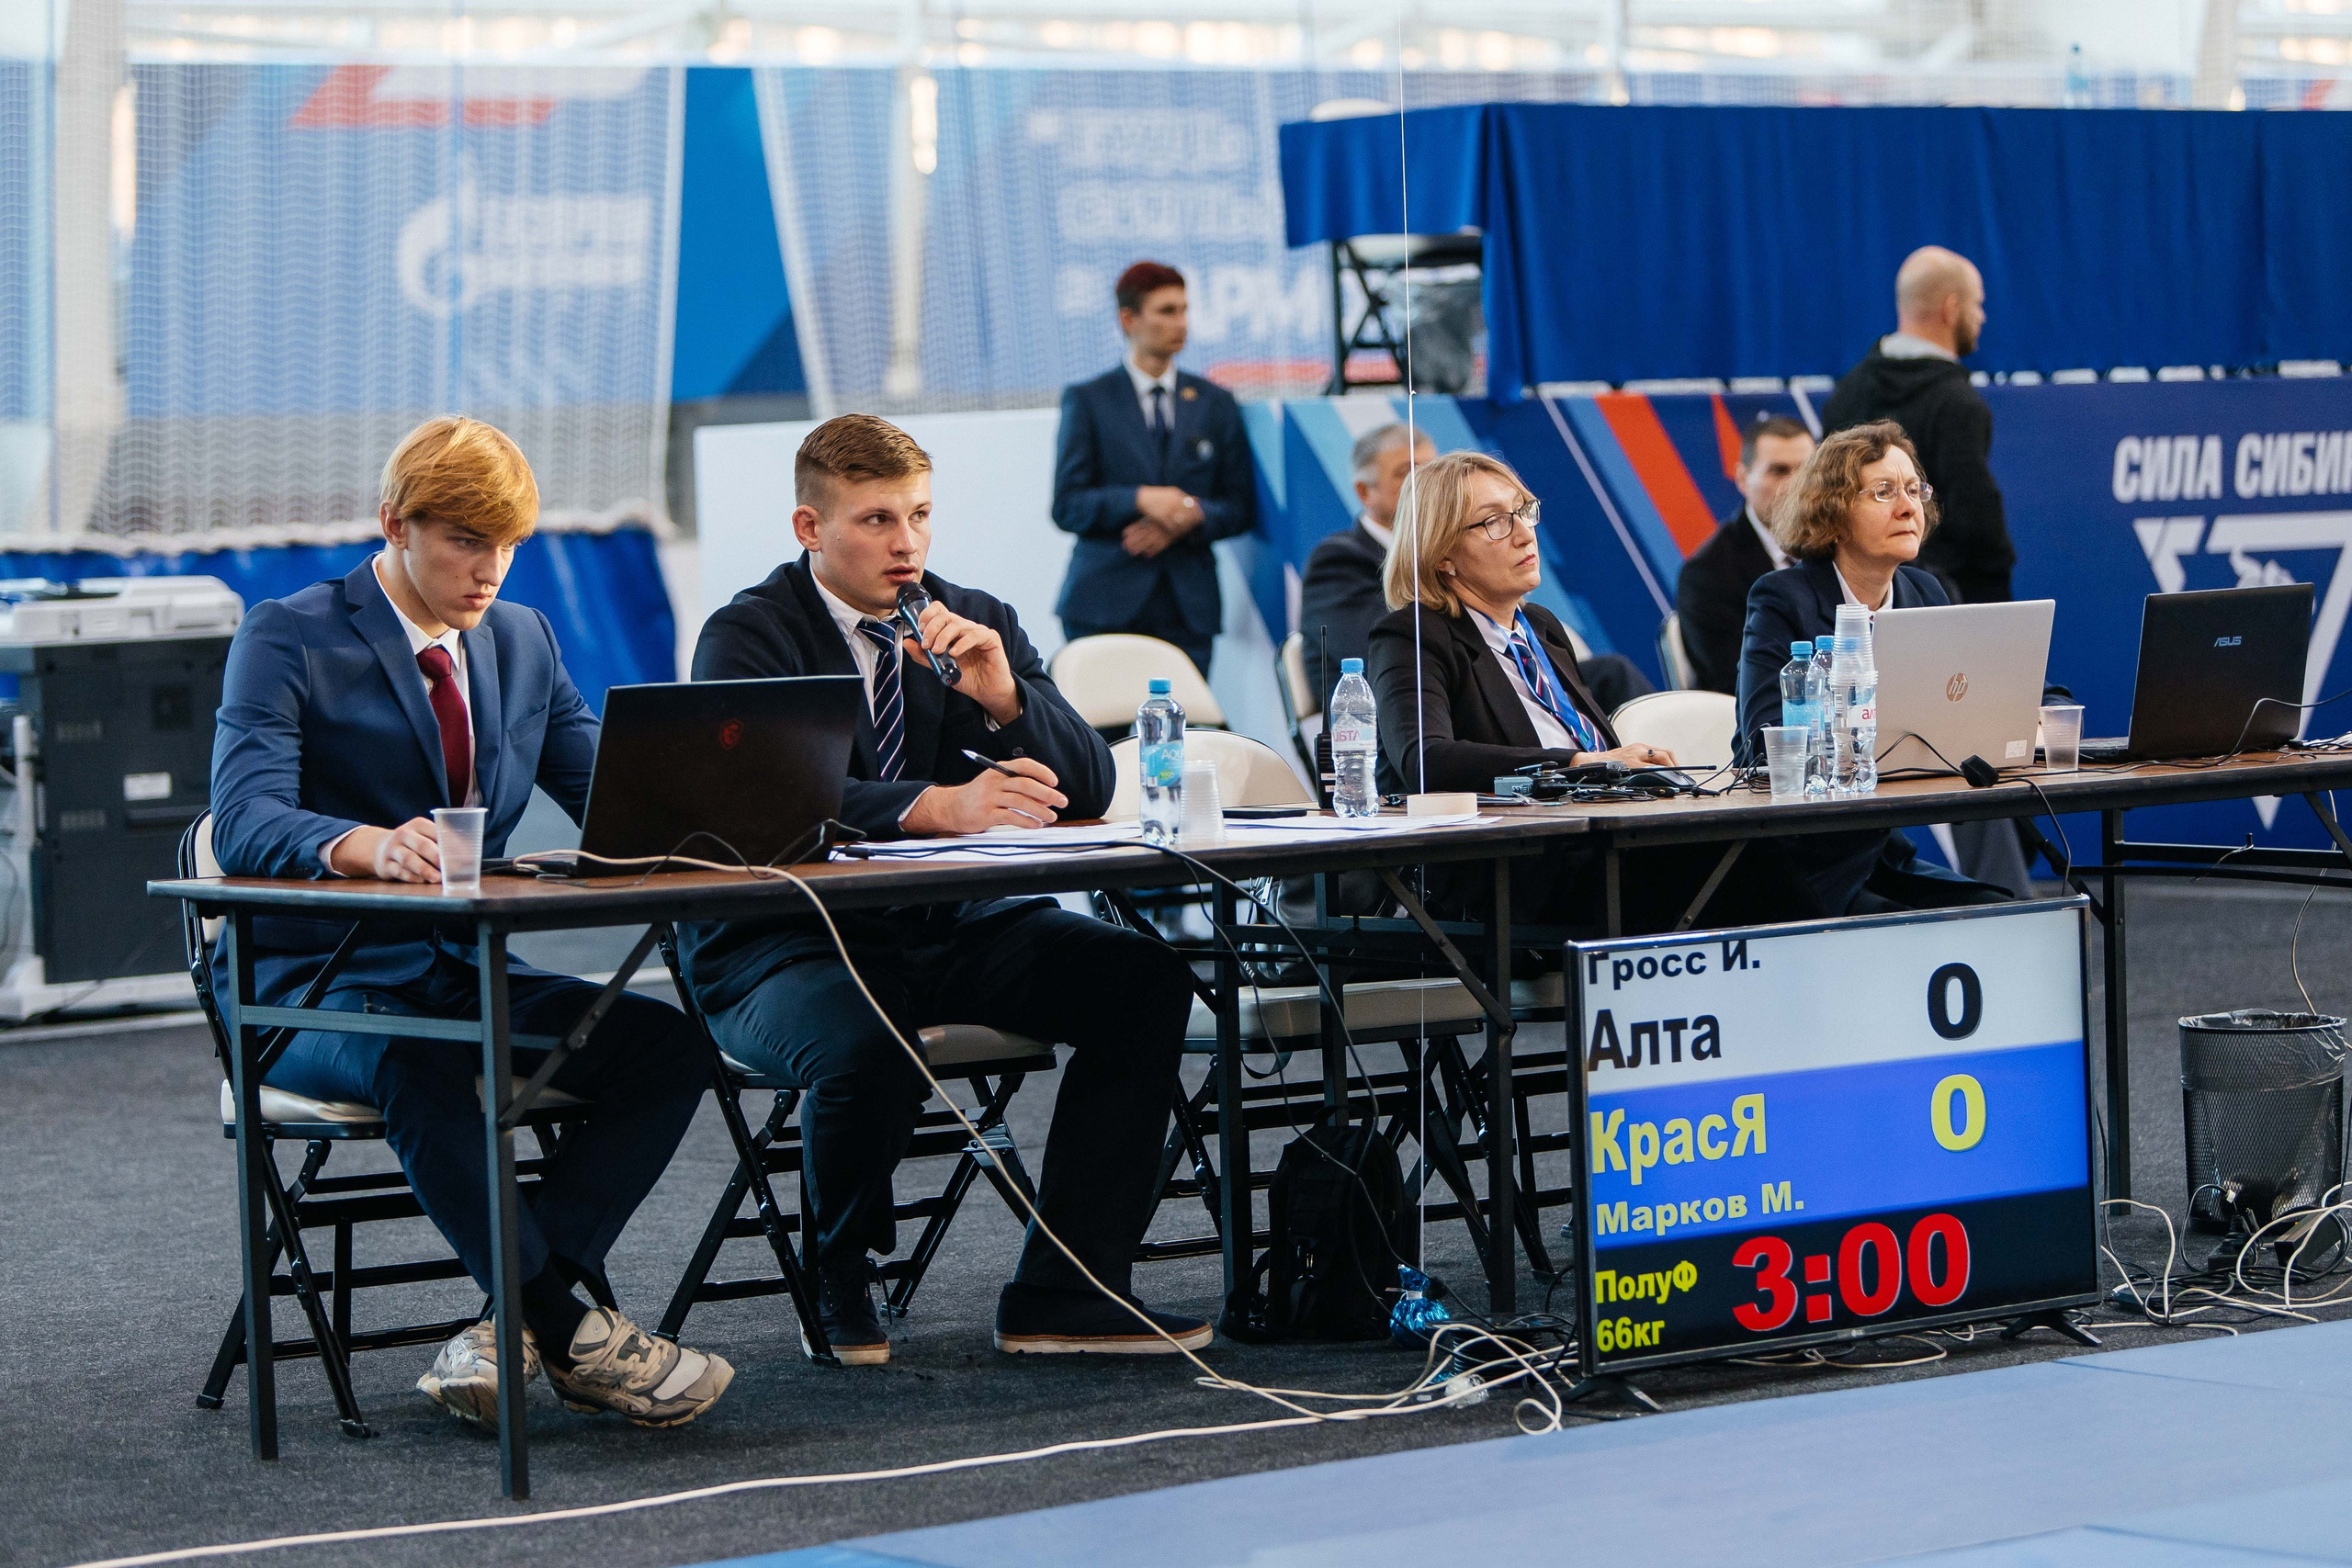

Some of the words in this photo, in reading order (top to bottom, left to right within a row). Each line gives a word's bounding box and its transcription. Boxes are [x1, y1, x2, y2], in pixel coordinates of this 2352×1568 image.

[2113, 434, 2222, 503] СИЛА
[2233, 431, 2352, 499] СИБИ
[2214, 636, 2242, 648] ASUS
[1947, 672, 1967, 703] hp
[1589, 951, 1707, 991] Гросс
[1722, 940, 1760, 972] И.
[1928, 962, 1983, 1041] 0
[1588, 1009, 1722, 1072] Алта
[1590, 1093, 1768, 1186] КрасЯ
[1930, 1073, 1987, 1152] 0
[1597, 1194, 1747, 1236] Марков
[1761, 1181, 1805, 1214] М.
[1595, 1260, 1698, 1304] ПолуФ
[1732, 1213, 1971, 1332] 3:00
[1597, 1315, 1666, 1353] 66кг
